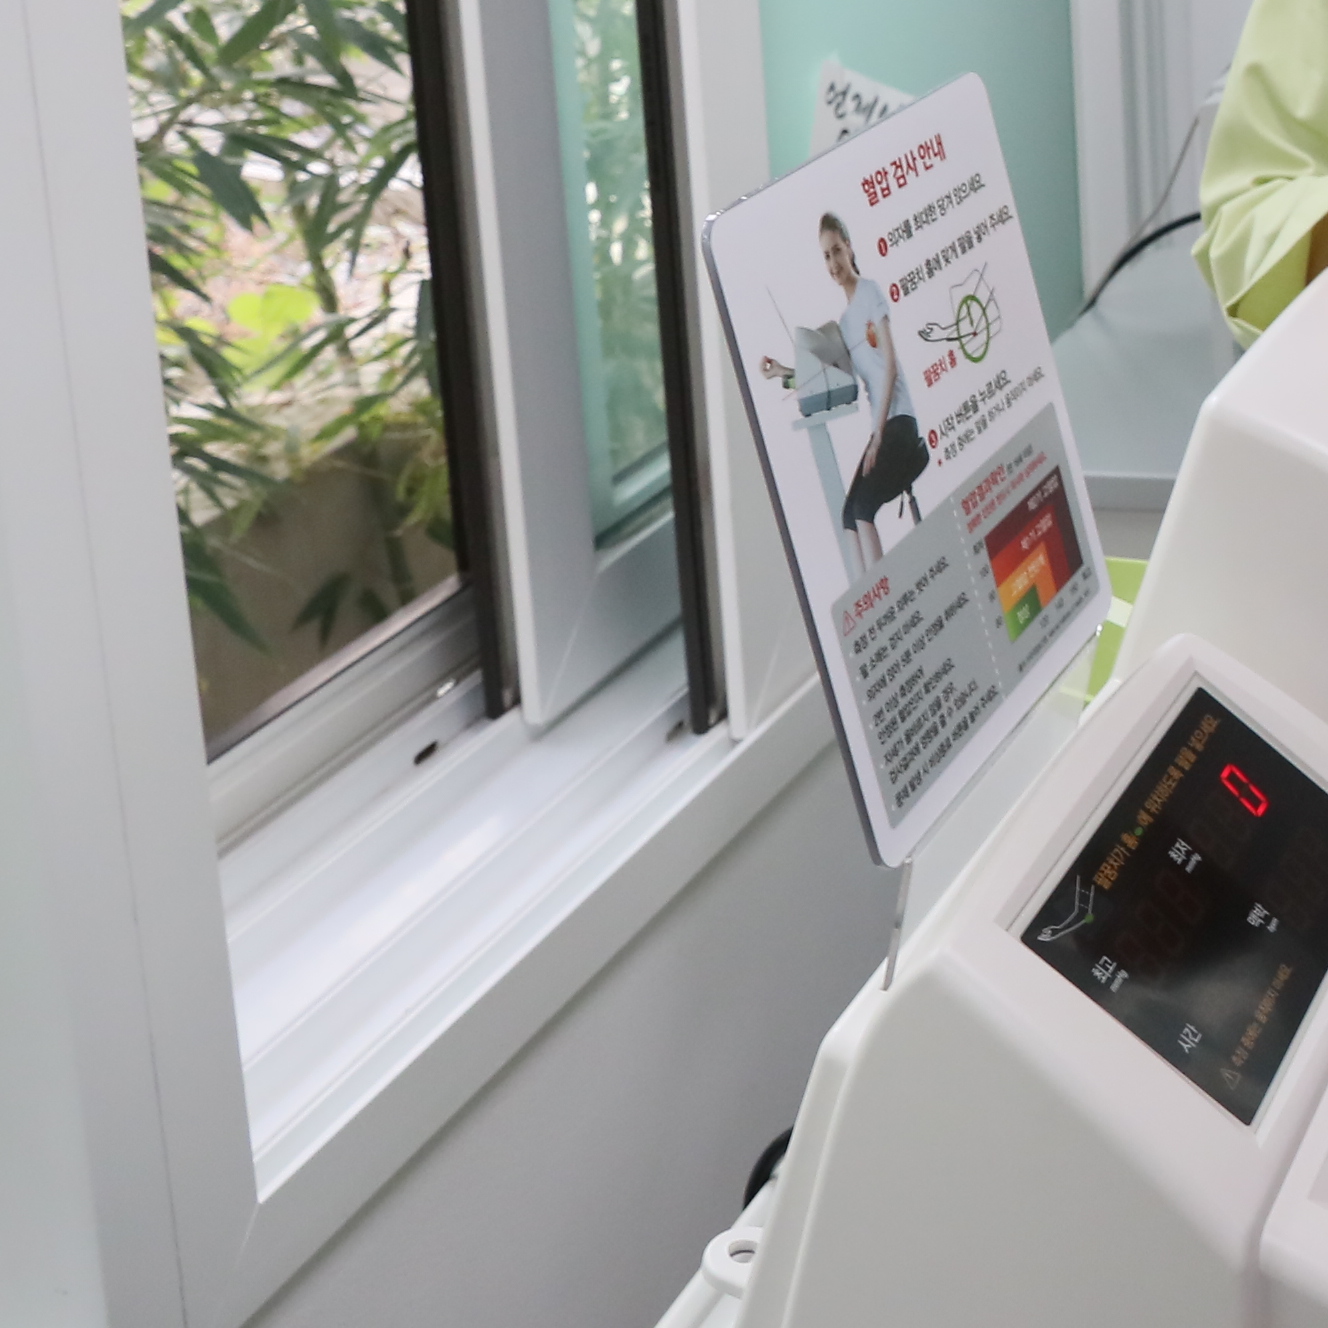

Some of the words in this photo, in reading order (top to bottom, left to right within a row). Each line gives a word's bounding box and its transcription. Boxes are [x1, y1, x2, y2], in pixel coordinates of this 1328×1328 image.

[825, 81, 888, 125] 언제
[860, 166, 892, 207] 혈압
[889, 150, 919, 189] 검사
[917, 133, 946, 172] 안내
[887, 218, 913, 247] 의자를
[912, 204, 938, 231] 최대한
[936, 192, 954, 217] 당겨
[898, 266, 925, 297] 팔꿈치
[938, 414, 956, 440] 시작
[954, 394, 979, 425] 버튼을
[854, 575, 890, 619] 주의사항
[1220, 763, 1269, 817] 0
[1092, 844, 1130, 890] 팔꿈치가
[1144, 765, 1184, 814] 위치하도록
[1168, 838, 1192, 864] 최저
[1246, 902, 1270, 927] 맥박
[1091, 955, 1117, 984] 최고
[1177, 1023, 1202, 1054] 시간
